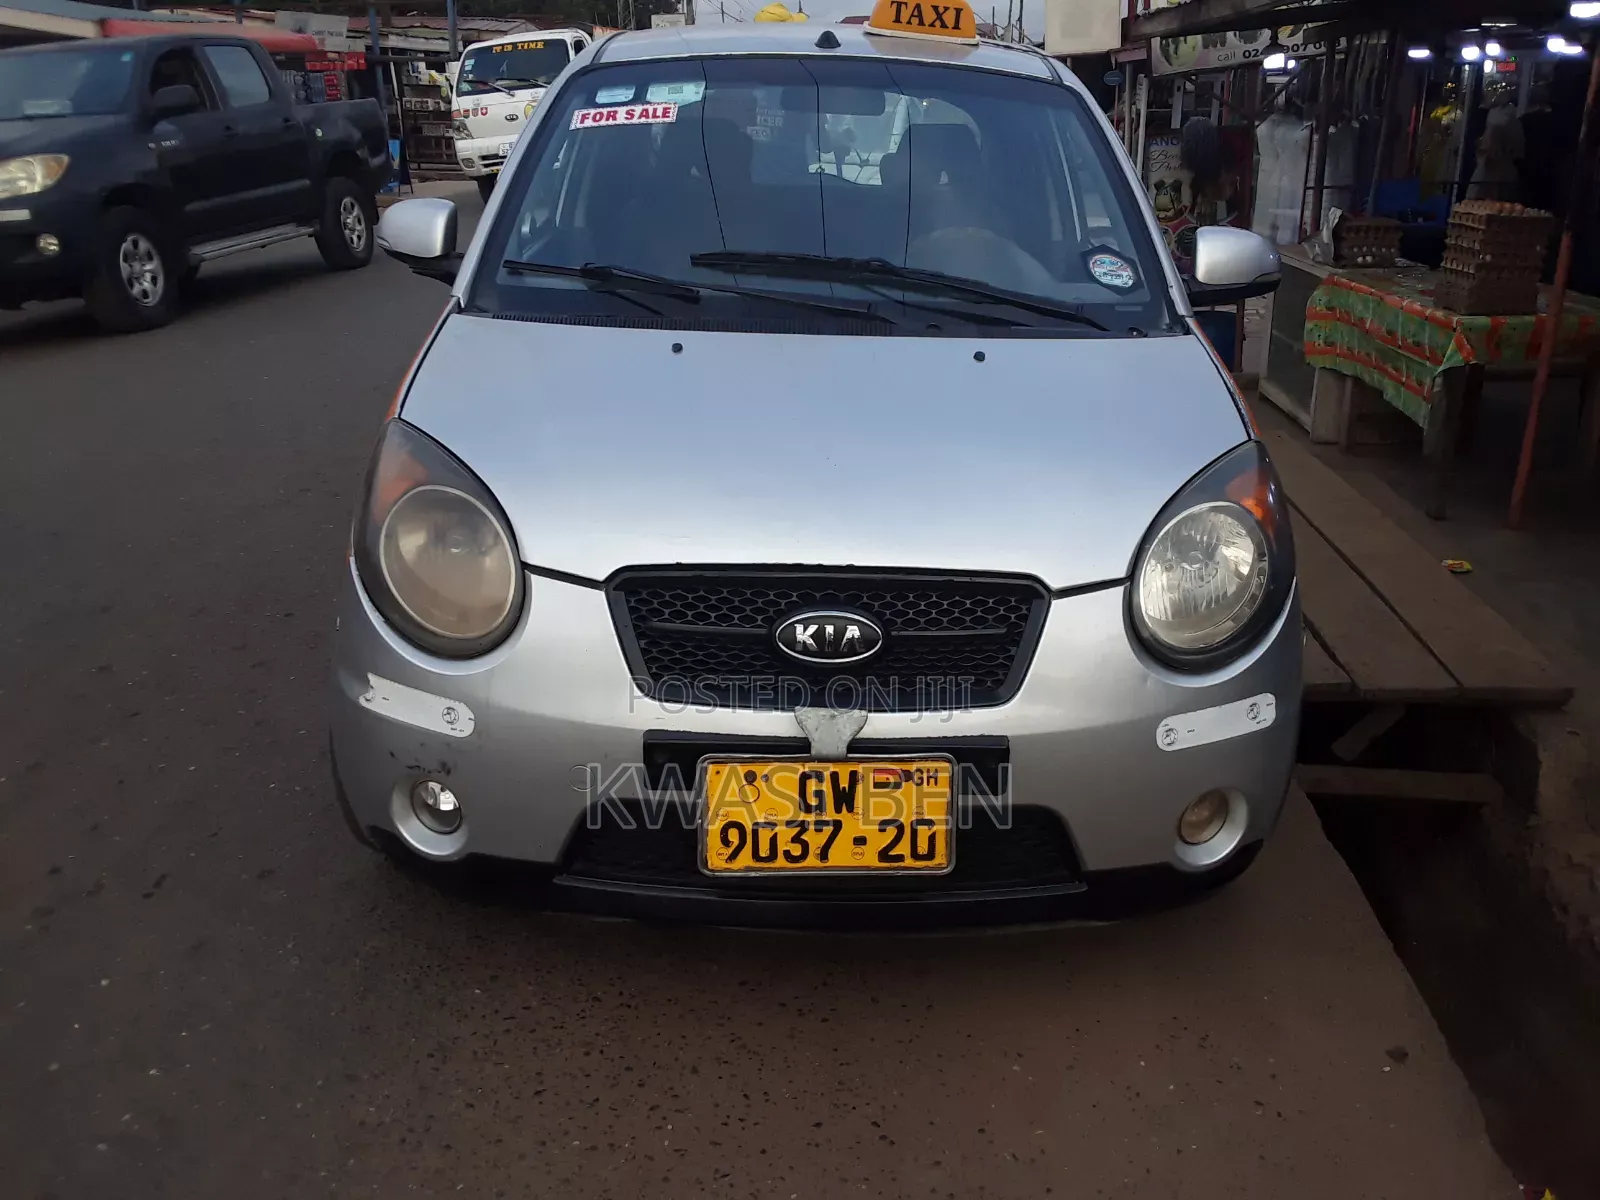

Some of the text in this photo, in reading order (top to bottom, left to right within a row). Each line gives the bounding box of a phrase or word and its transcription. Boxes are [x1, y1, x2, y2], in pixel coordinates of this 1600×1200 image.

[889, 0, 964, 30] TAXI
[516, 41, 545, 50] TIME
[1217, 51, 1236, 62] call
[579, 106, 672, 125] FOR SALE
[794, 623, 866, 652] KIA
[912, 768, 939, 787] GH
[799, 770, 858, 815] GW
